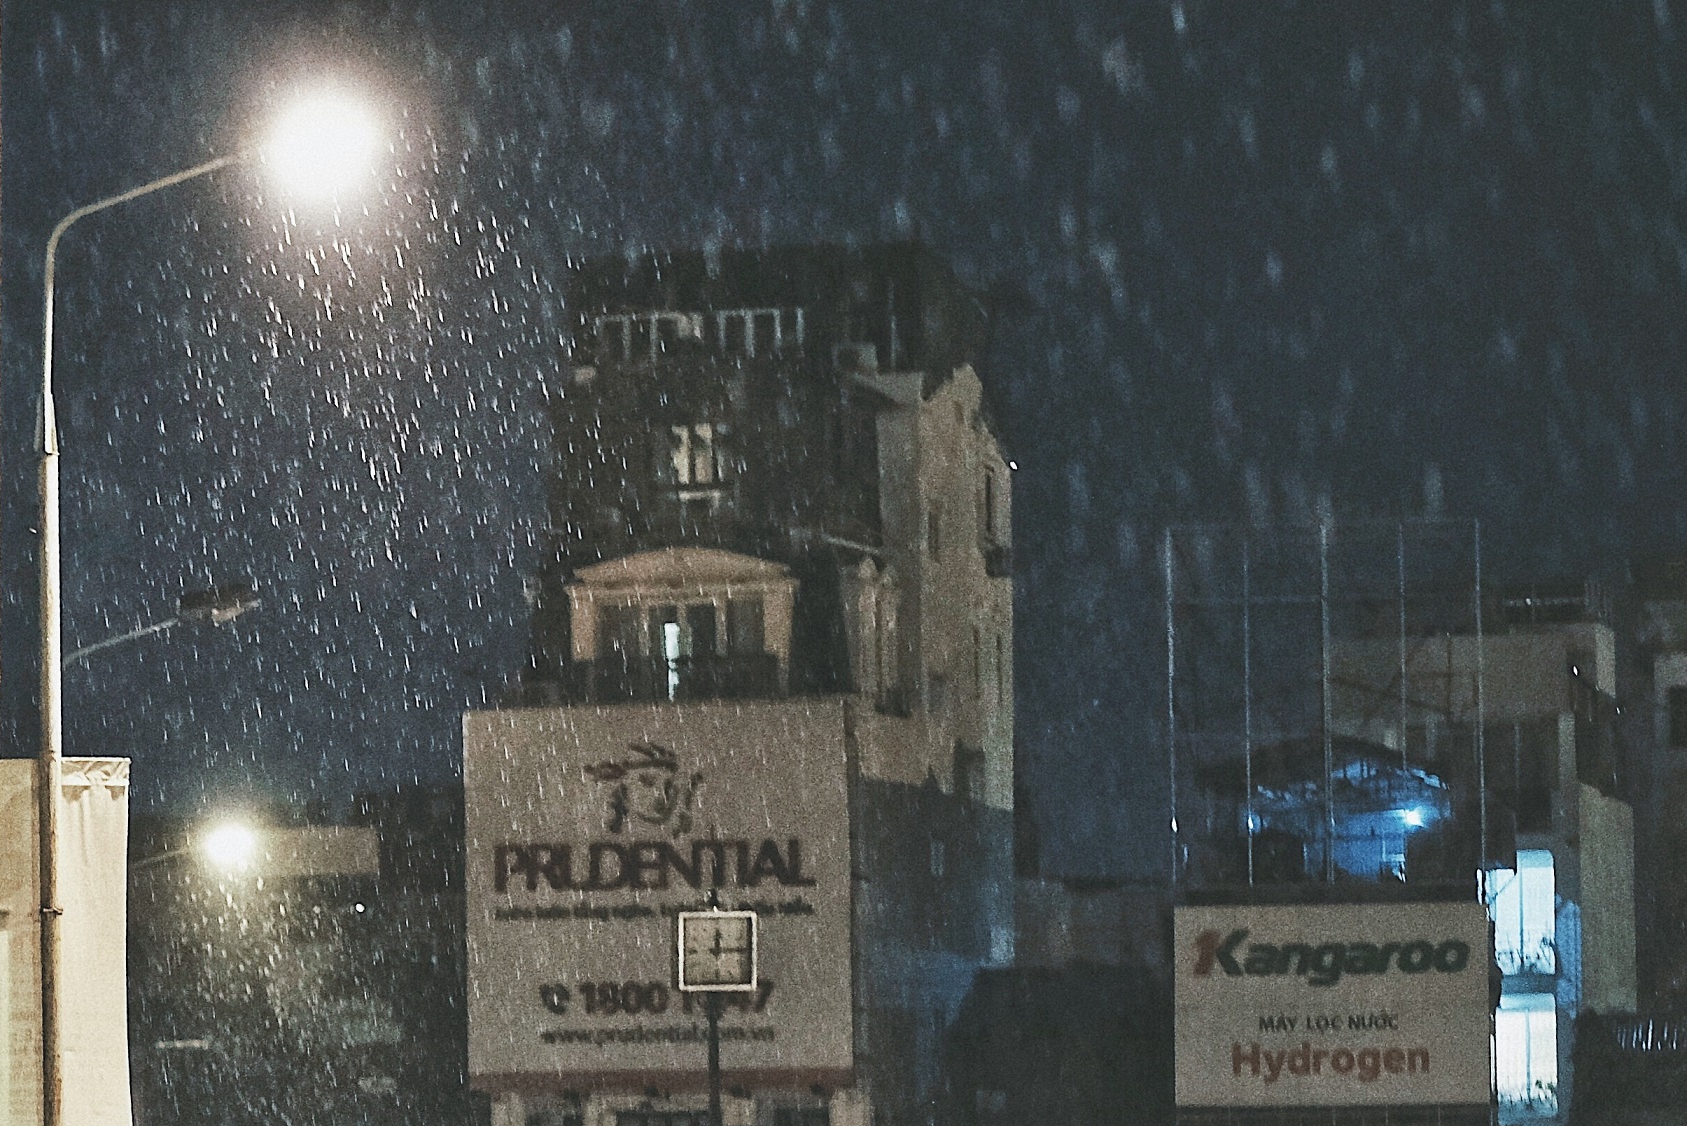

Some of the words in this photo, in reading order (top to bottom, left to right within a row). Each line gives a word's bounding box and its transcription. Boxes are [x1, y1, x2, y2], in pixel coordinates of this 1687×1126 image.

[493, 839, 816, 892] PRUDENTIAL
[1193, 928, 1469, 986] Kangaroo
[579, 982, 669, 1015] 1800
[1259, 1012, 1297, 1032] MÁY
[1231, 1041, 1430, 1085] Hydrogen
